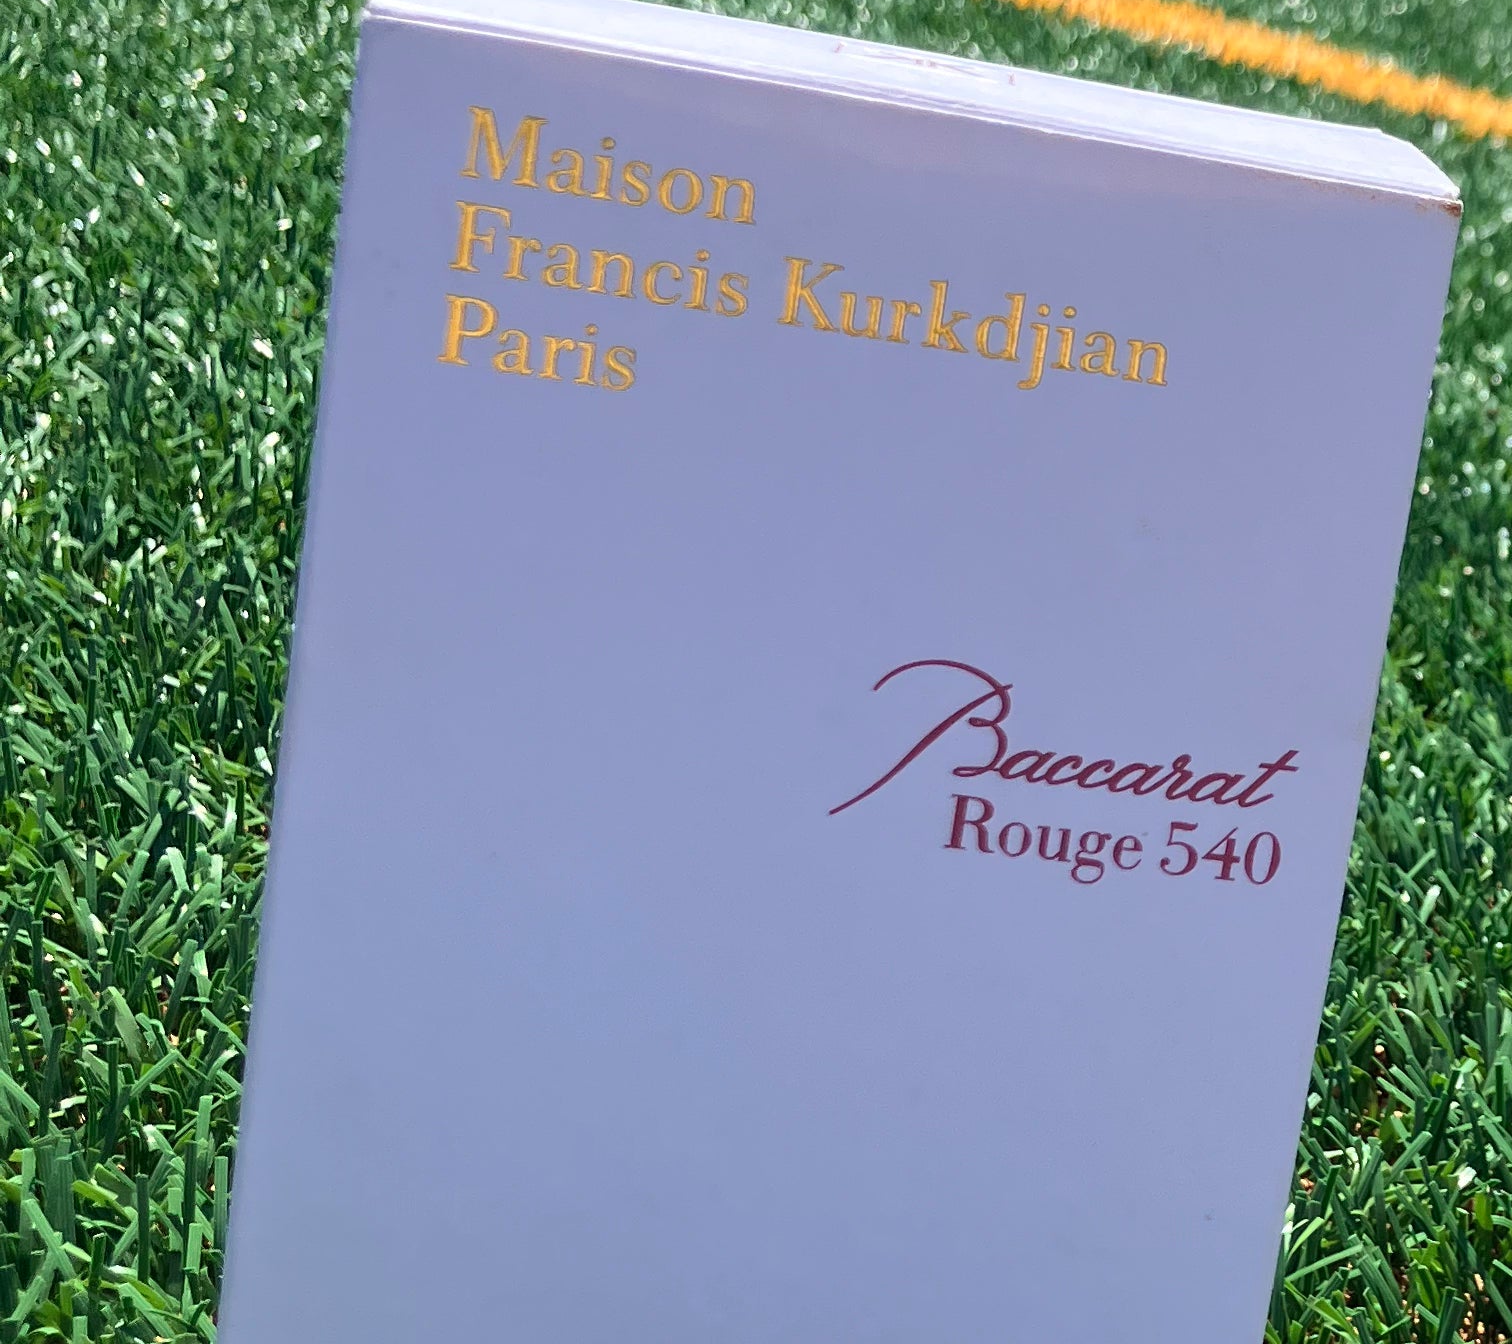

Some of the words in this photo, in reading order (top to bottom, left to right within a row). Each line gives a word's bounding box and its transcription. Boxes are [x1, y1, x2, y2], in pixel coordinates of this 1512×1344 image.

[460, 105, 757, 225] Maison
[438, 293, 637, 391] Paris
[450, 200, 750, 318] Francis
[777, 256, 1169, 391] Kurkdjian
[829, 659, 1300, 815] Baccarat
[944, 793, 1144, 884] Rouge
[1160, 821, 1281, 885] 540
